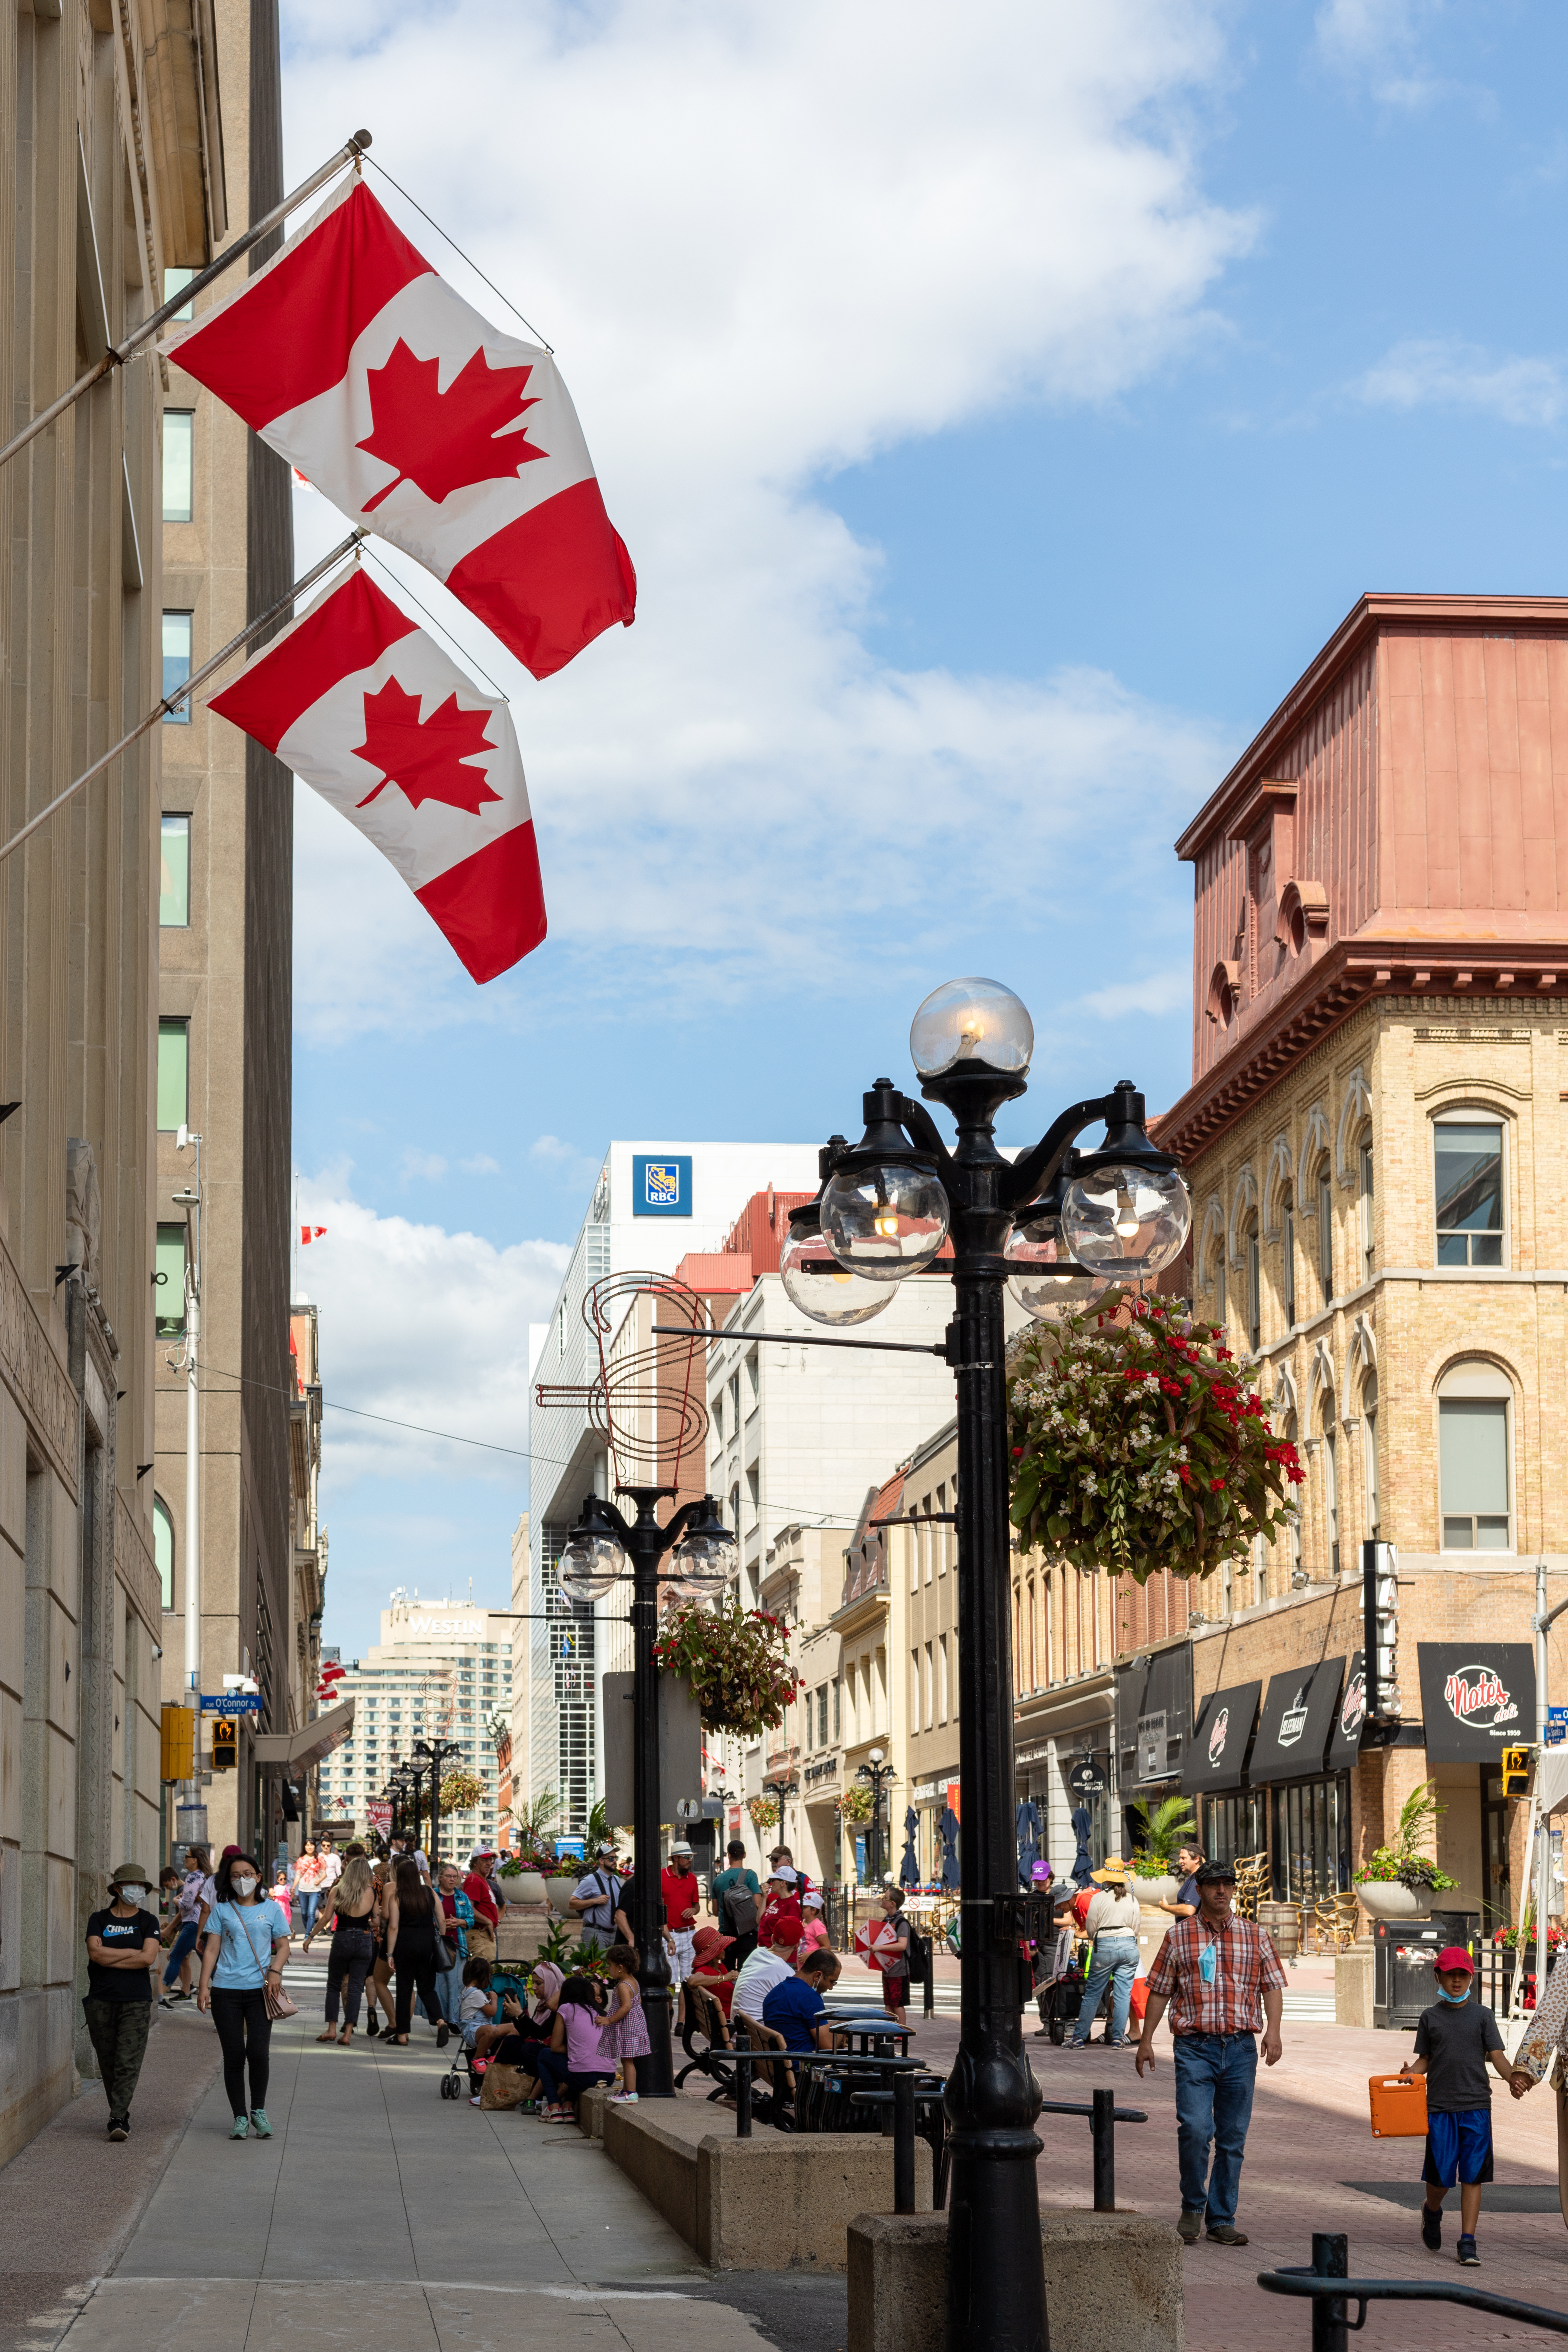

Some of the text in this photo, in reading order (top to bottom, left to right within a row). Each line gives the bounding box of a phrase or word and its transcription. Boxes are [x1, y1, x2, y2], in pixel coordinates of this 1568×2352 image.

[650, 1192, 675, 1202] RBC
[408, 1616, 482, 1635] WESTIN
[1444, 1672, 1511, 1718] Nate's
[216, 1698, 249, 1707] O'Connor
[1494, 1703, 1519, 1723] deli
[1281, 1716, 1304, 1736] SLEEMAN
[372, 1805, 391, 1814] Wifi
[106, 1924, 134, 1934] CHINA
